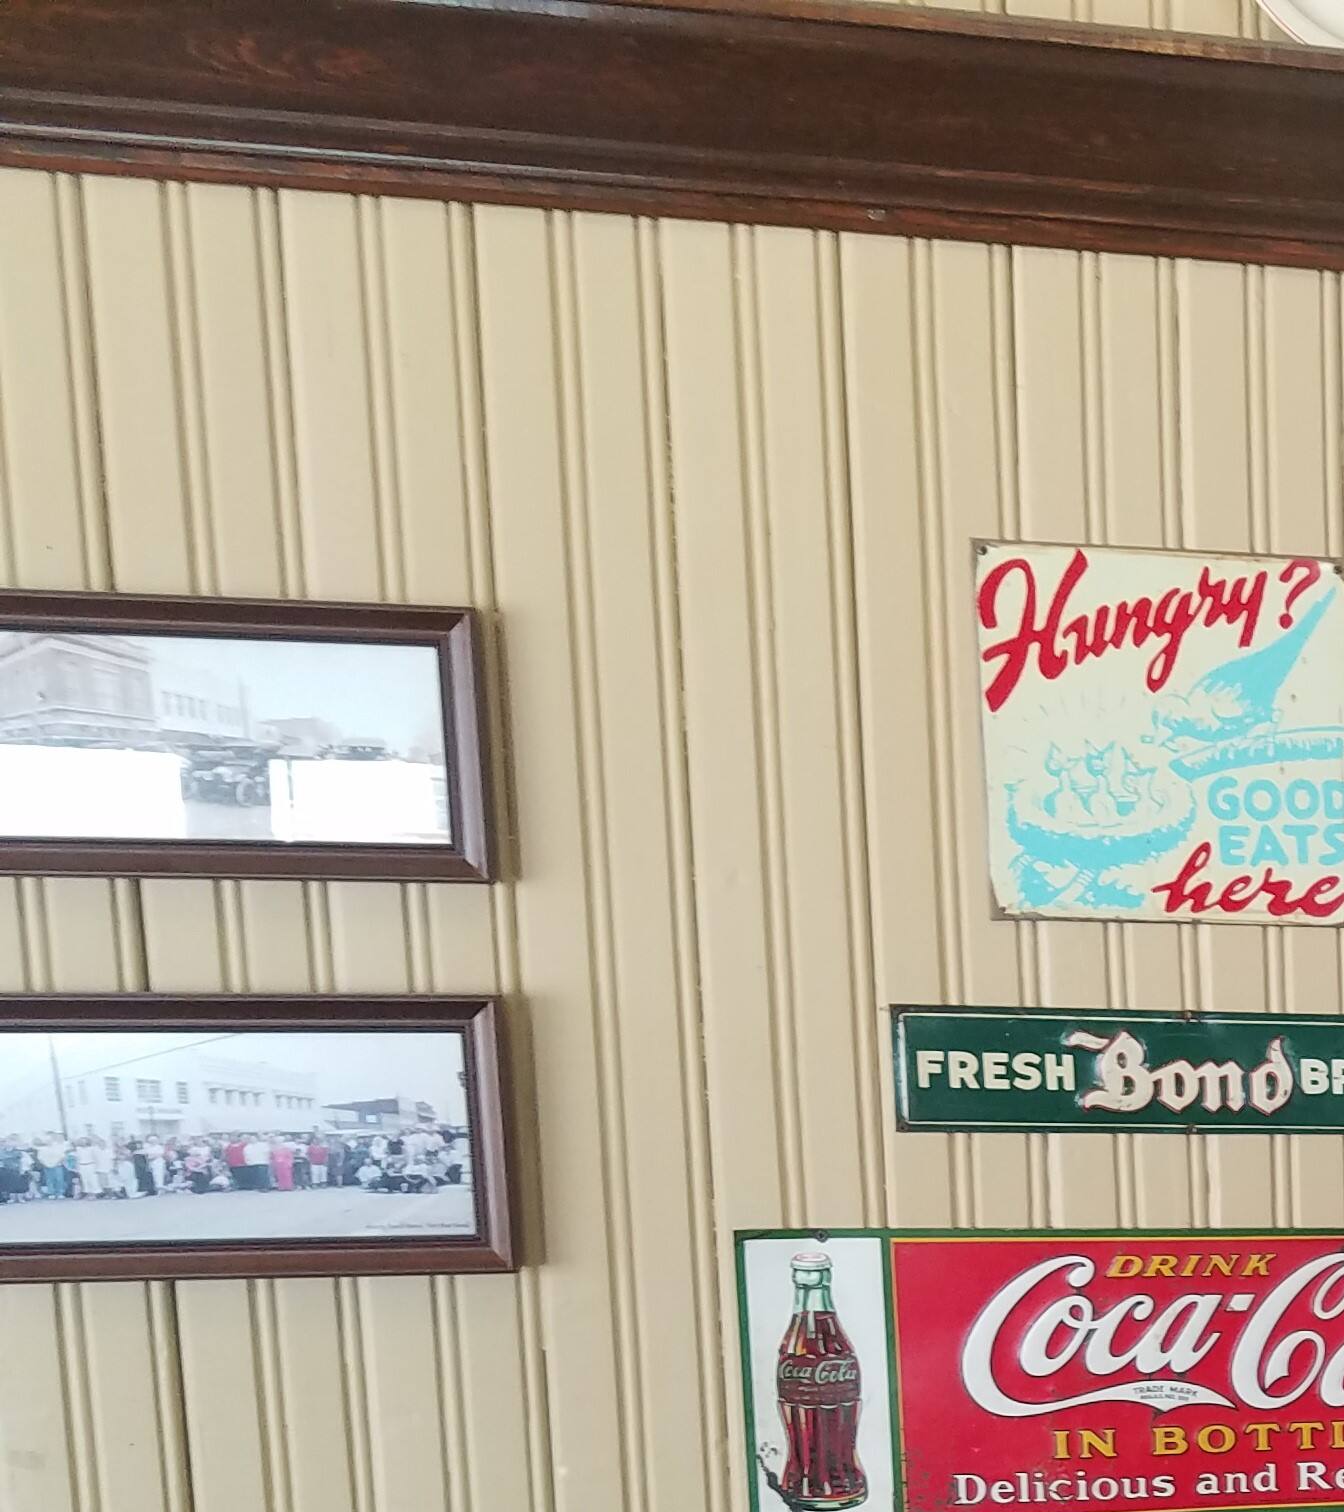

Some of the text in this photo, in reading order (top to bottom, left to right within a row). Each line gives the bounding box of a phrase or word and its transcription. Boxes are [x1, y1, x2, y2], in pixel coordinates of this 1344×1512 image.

[977, 549, 1321, 713] Hungry?
[916, 1051, 1075, 1091] FRESH
[1065, 1029, 1295, 1114] Bond
[1106, 1253, 1277, 1278] DRINK
[1053, 1427, 1117, 1460] IN
[953, 1472, 1177, 1506] Delicious
[1195, 1462, 1279, 1496] and
